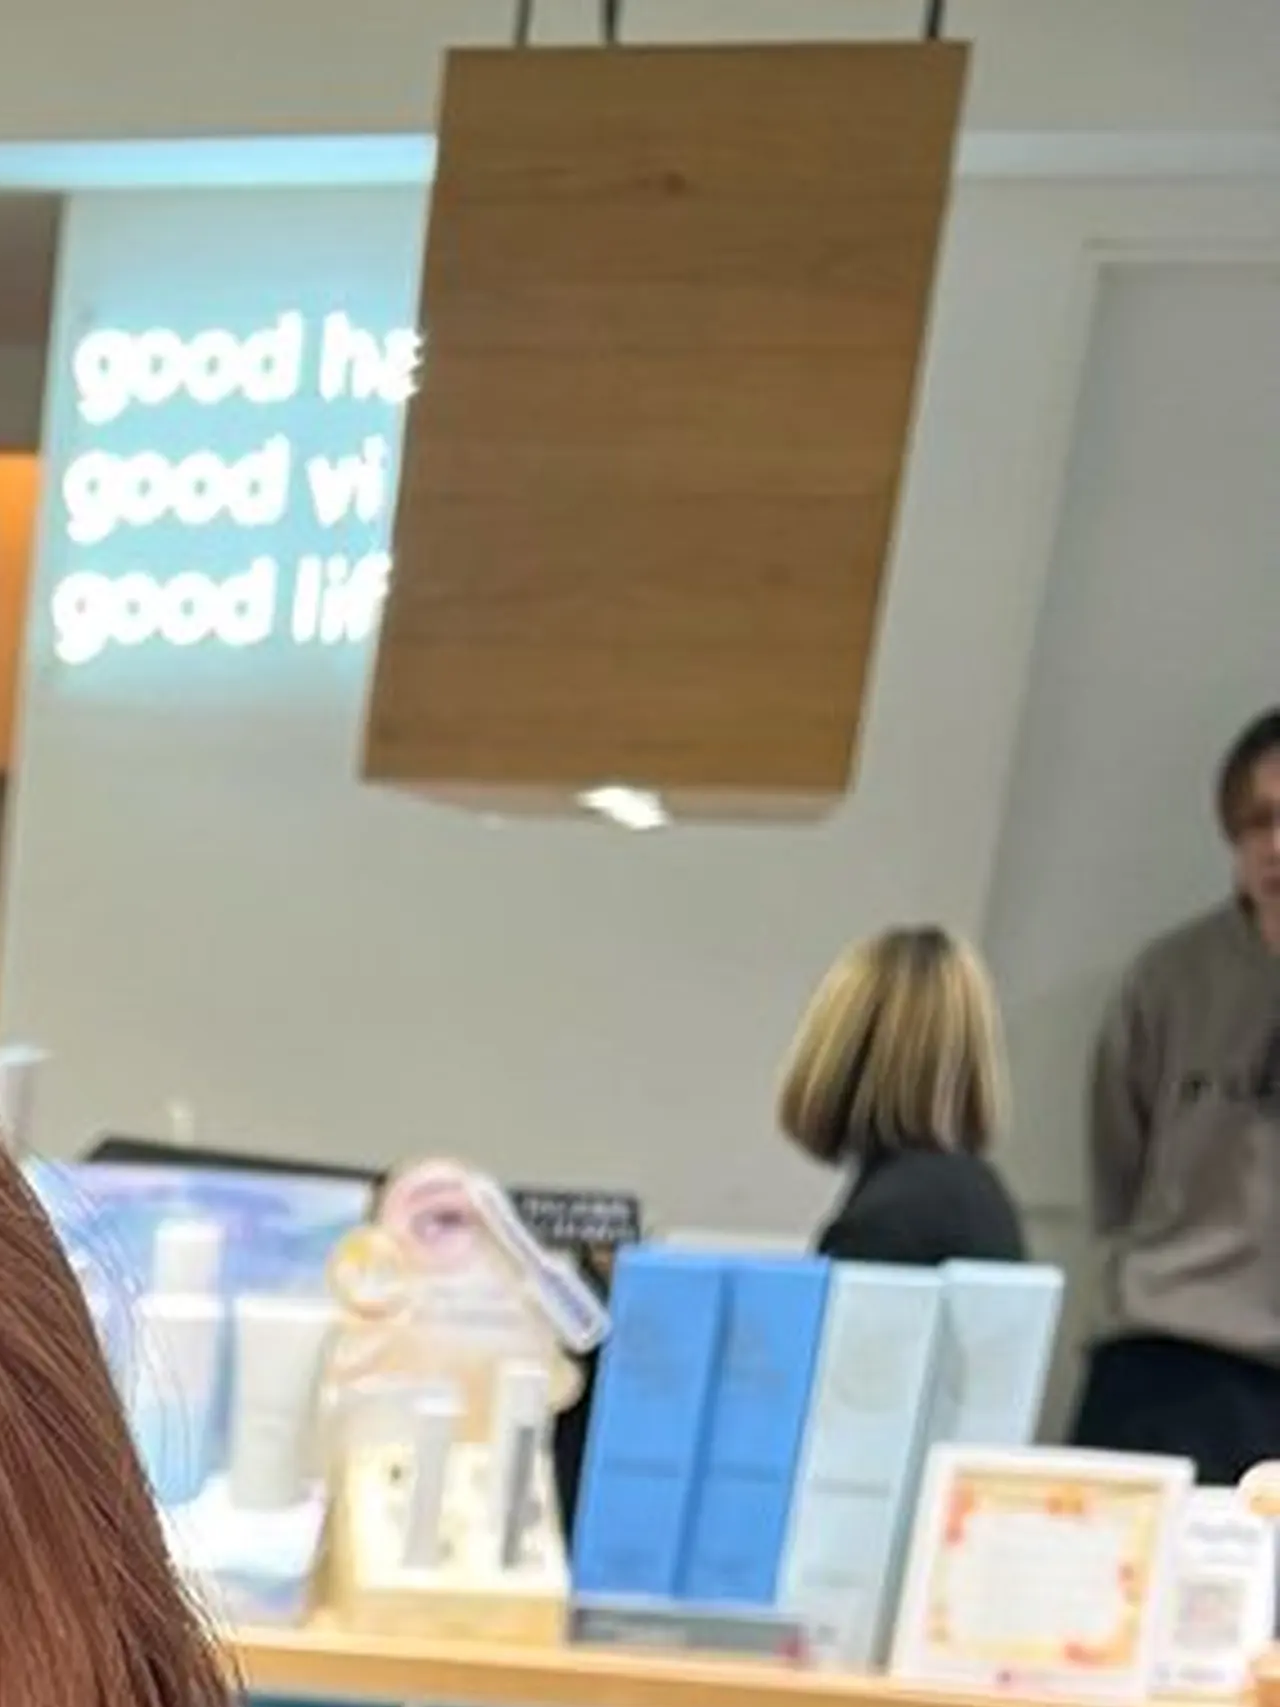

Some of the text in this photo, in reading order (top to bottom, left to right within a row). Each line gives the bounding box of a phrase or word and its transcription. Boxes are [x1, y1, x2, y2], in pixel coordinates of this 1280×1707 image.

[73, 310, 303, 425] good
[63, 434, 386, 545] good vi
[52, 555, 277, 664] good
